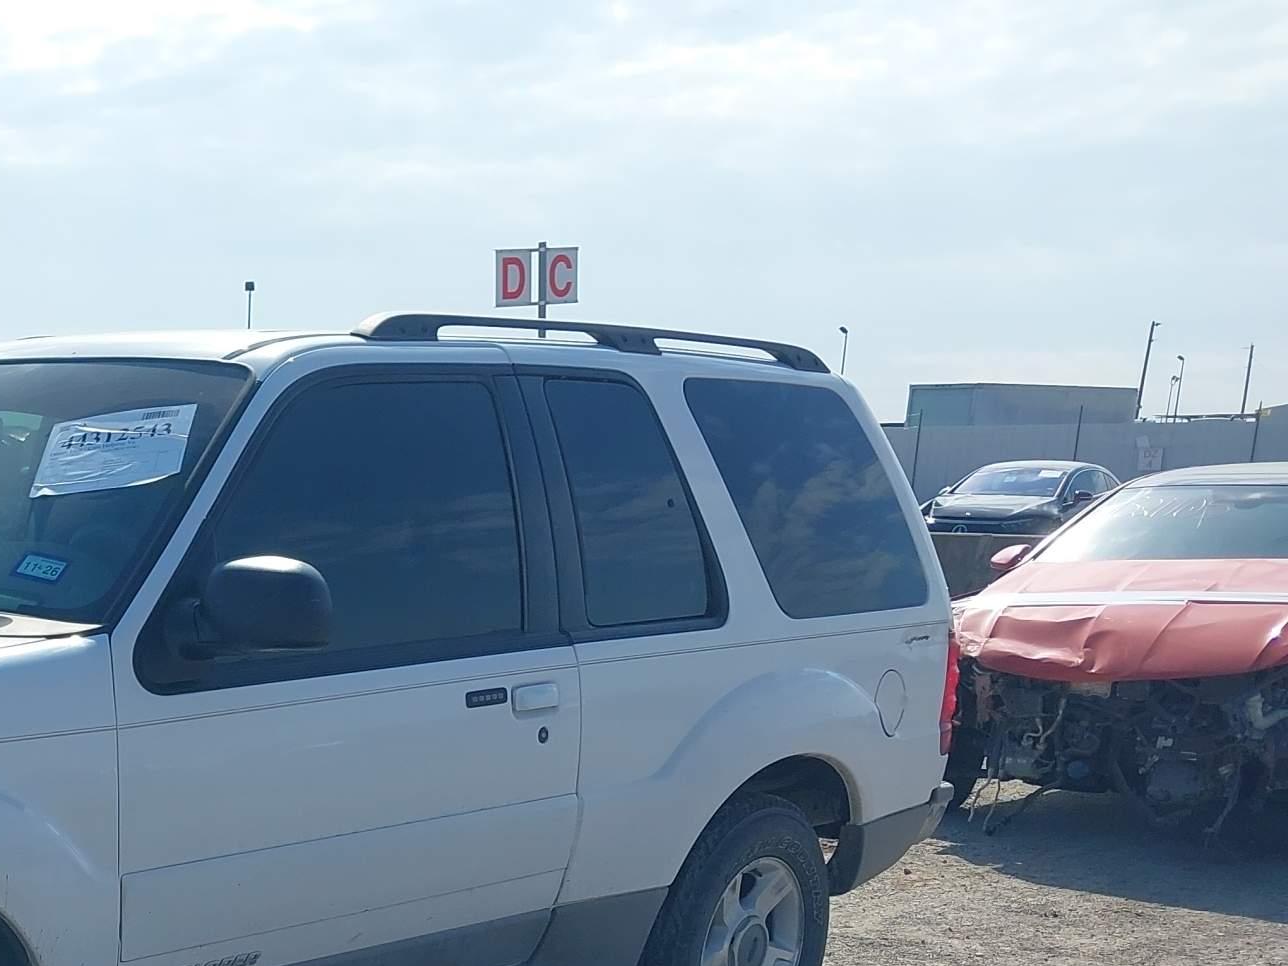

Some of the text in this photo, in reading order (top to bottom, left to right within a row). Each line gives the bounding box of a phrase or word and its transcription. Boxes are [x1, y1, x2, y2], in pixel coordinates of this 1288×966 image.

[502, 256, 526, 300] D
[549, 254, 572, 298] C
[60, 422, 172, 449] 44312543
